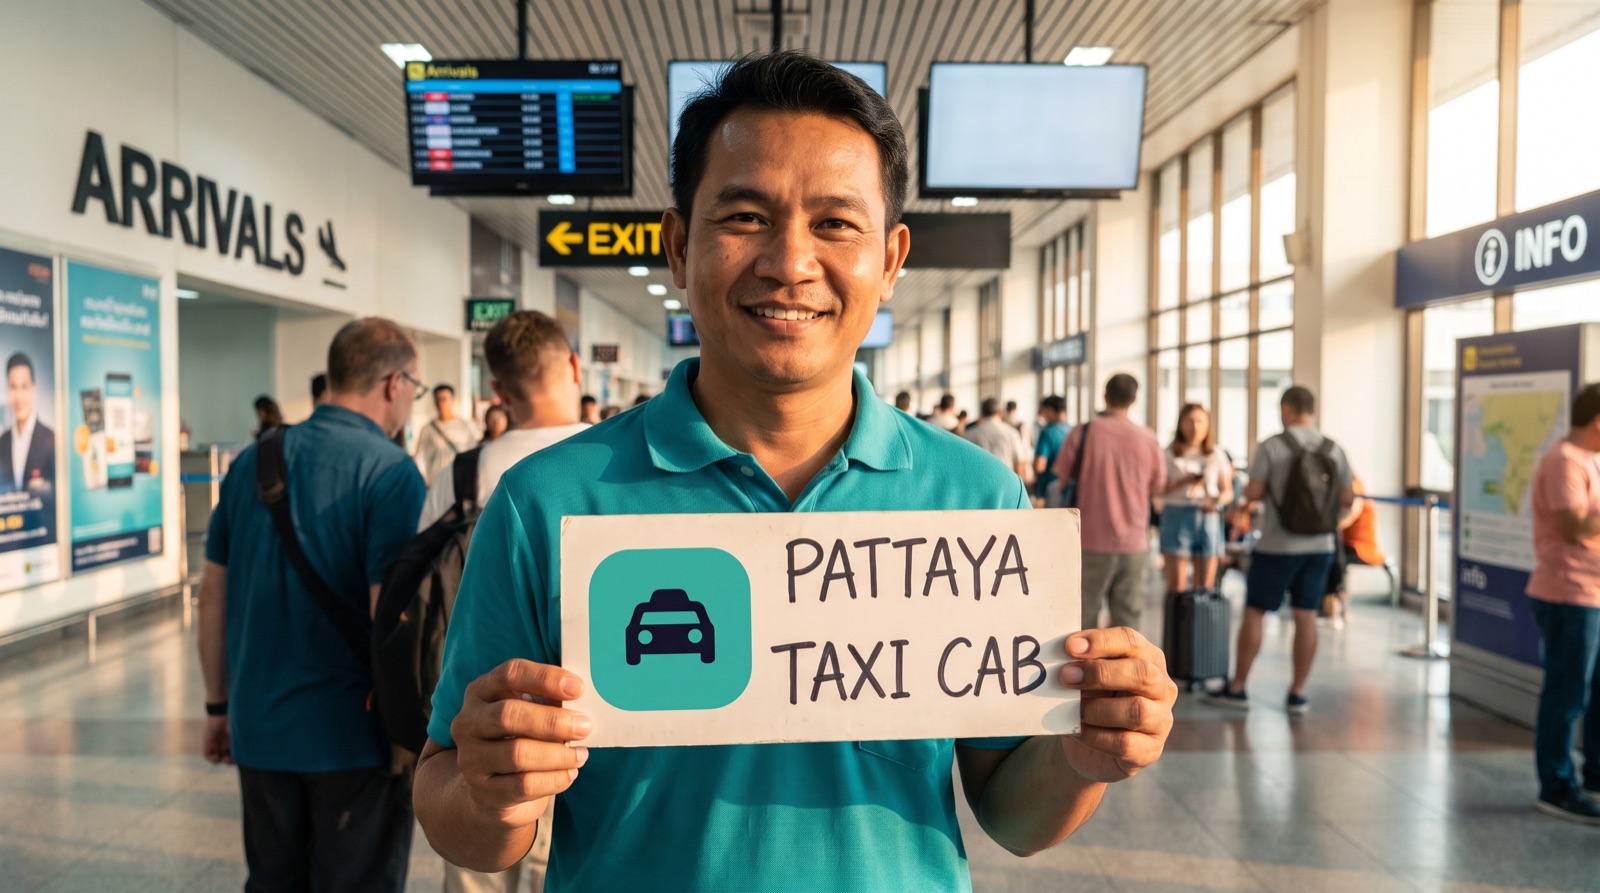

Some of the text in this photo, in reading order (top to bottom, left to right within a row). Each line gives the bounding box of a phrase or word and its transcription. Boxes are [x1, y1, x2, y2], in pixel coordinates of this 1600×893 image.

[427, 64, 479, 79] Arrivals
[71, 128, 305, 276] ARRIVALS
[588, 222, 661, 256] EXIT
[1514, 214, 1588, 272] INFO
[786, 533, 1029, 603] PATTAYA
[770, 635, 1047, 705] TAXI CAB
